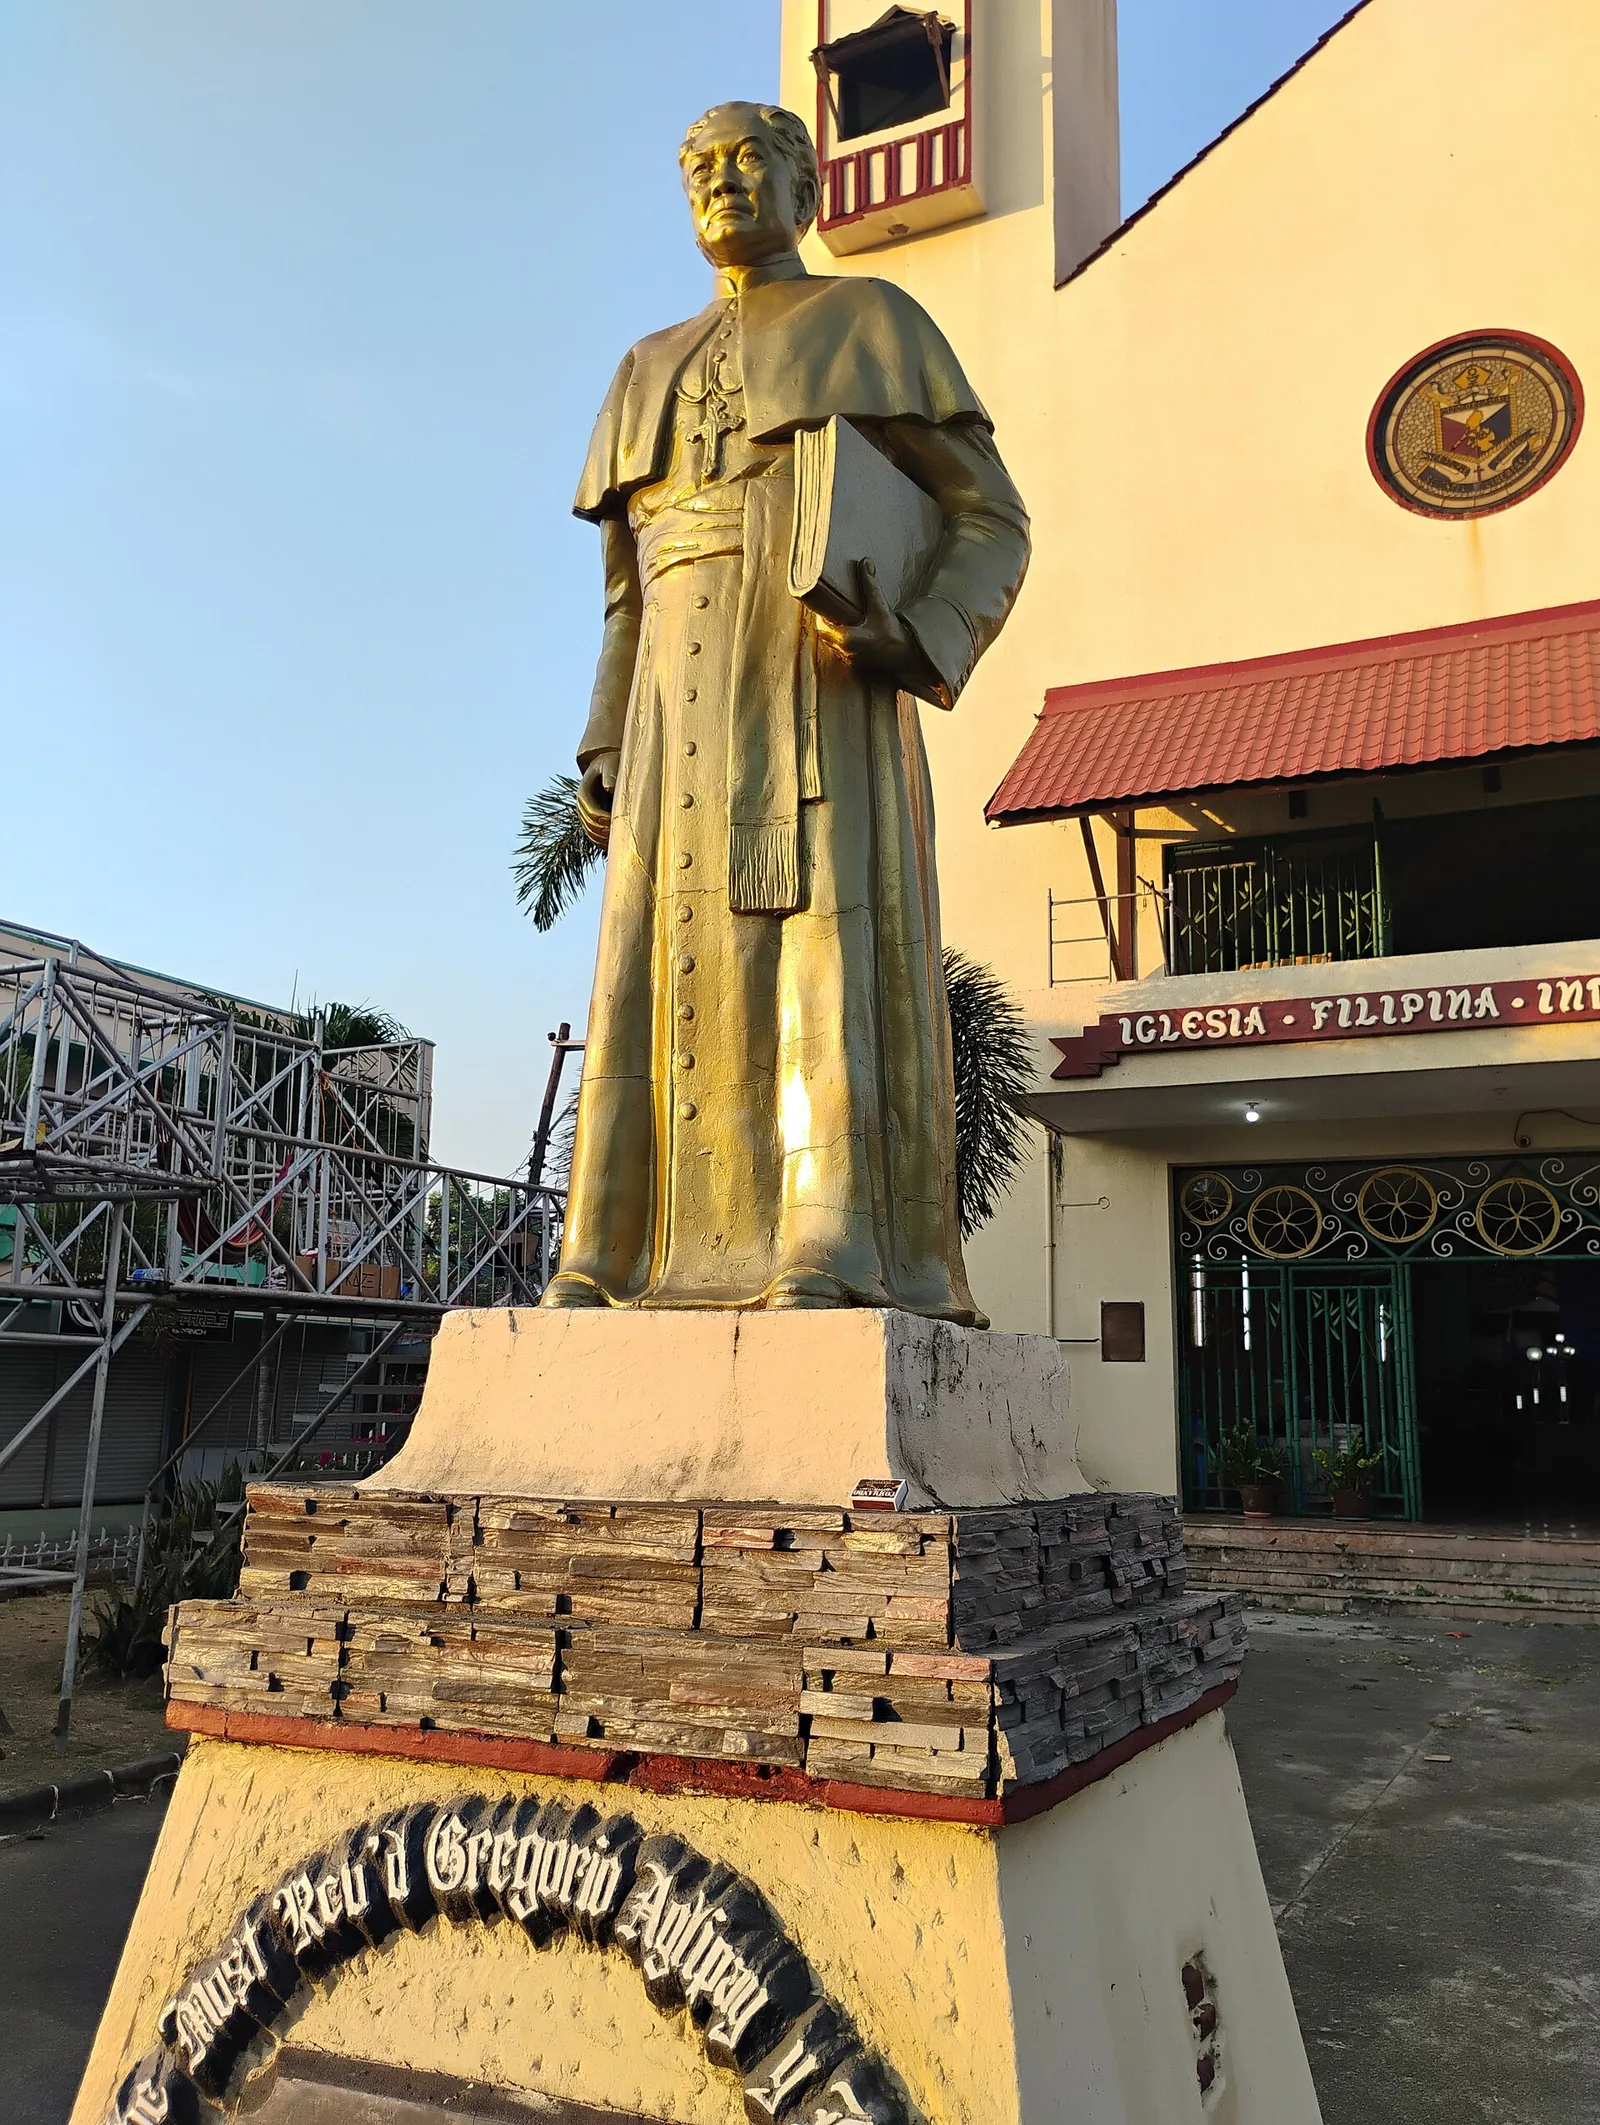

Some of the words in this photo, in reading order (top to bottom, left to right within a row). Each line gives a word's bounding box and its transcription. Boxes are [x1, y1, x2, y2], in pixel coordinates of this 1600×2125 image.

[1119, 1006, 1266, 1045] IGLESIA
[1311, 986, 1500, 1031] FILIPINA
[158, 1918, 268, 2074] Most
[425, 1814, 622, 1920] Gregorio
[618, 1862, 769, 2049] Aglipay
